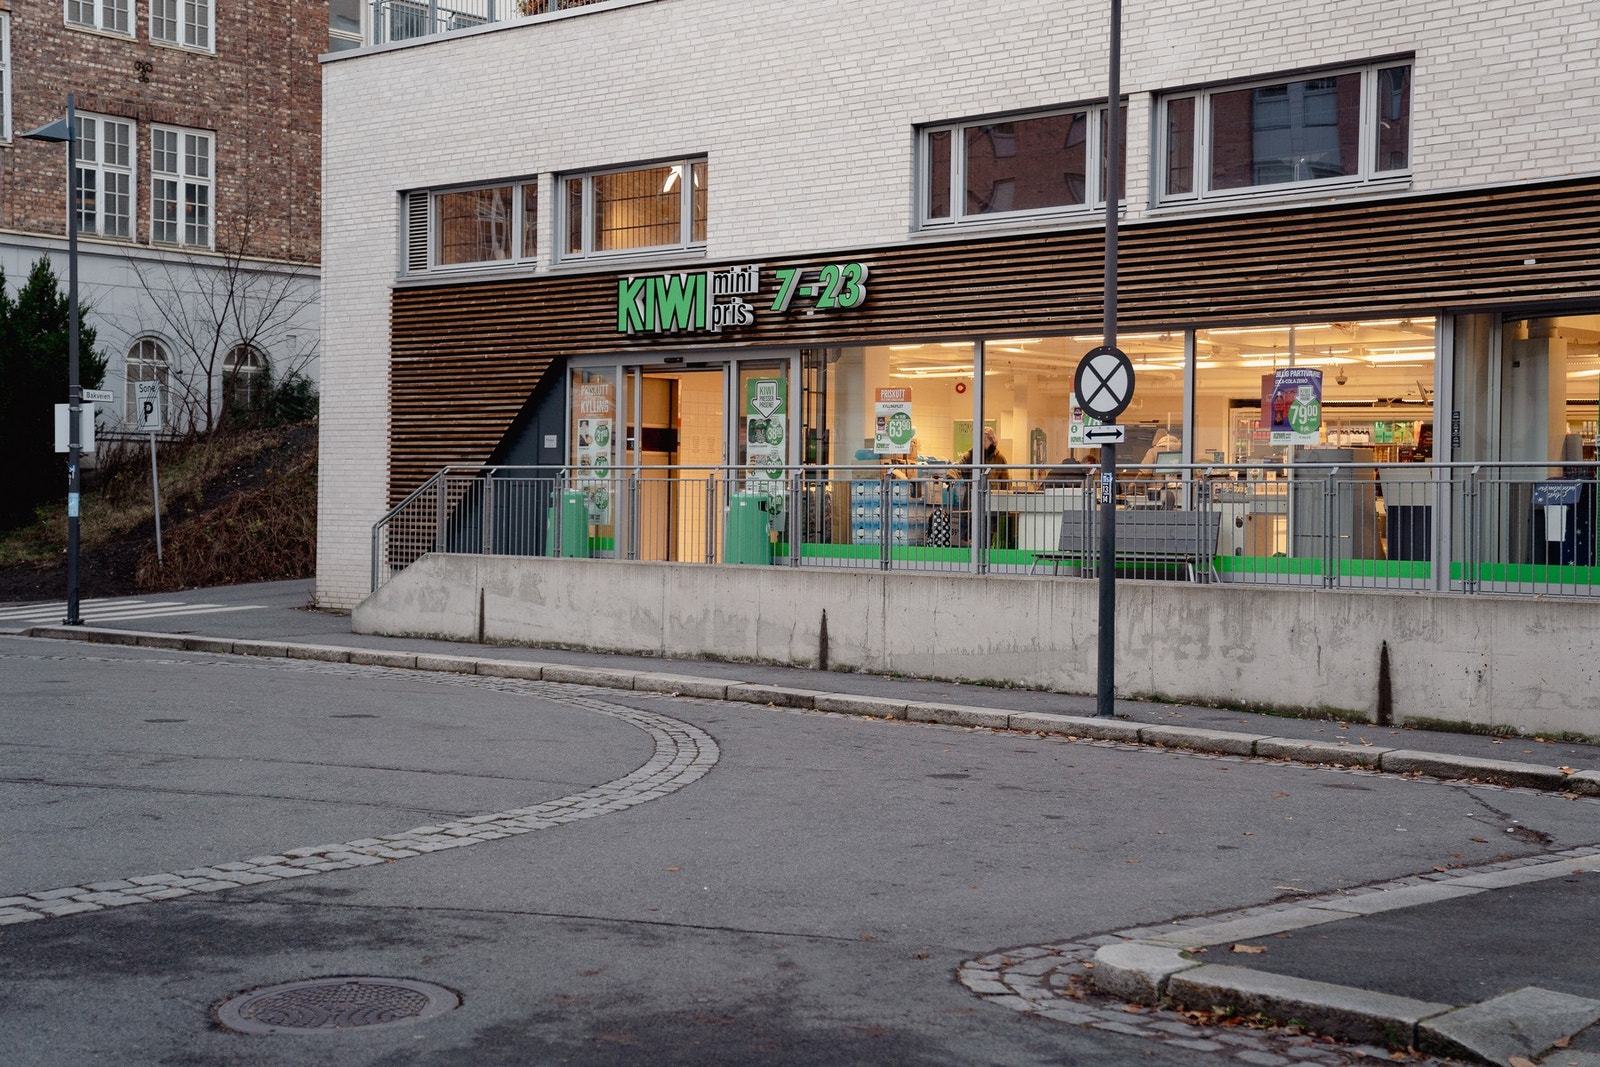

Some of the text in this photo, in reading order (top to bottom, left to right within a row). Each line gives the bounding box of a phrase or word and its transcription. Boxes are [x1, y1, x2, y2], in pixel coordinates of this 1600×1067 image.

[711, 265, 759, 296] mini
[770, 262, 868, 312] 7-23
[617, 273, 707, 333] KIWI
[711, 297, 753, 332] pris
[86, 392, 111, 400] Bakveien
[138, 384, 156, 393] Sone
[759, 386, 774, 395] KIWI
[881, 389, 905, 398] PRISKUTT
[143, 401, 154, 422] P
[580, 399, 609, 413] KYLLING
